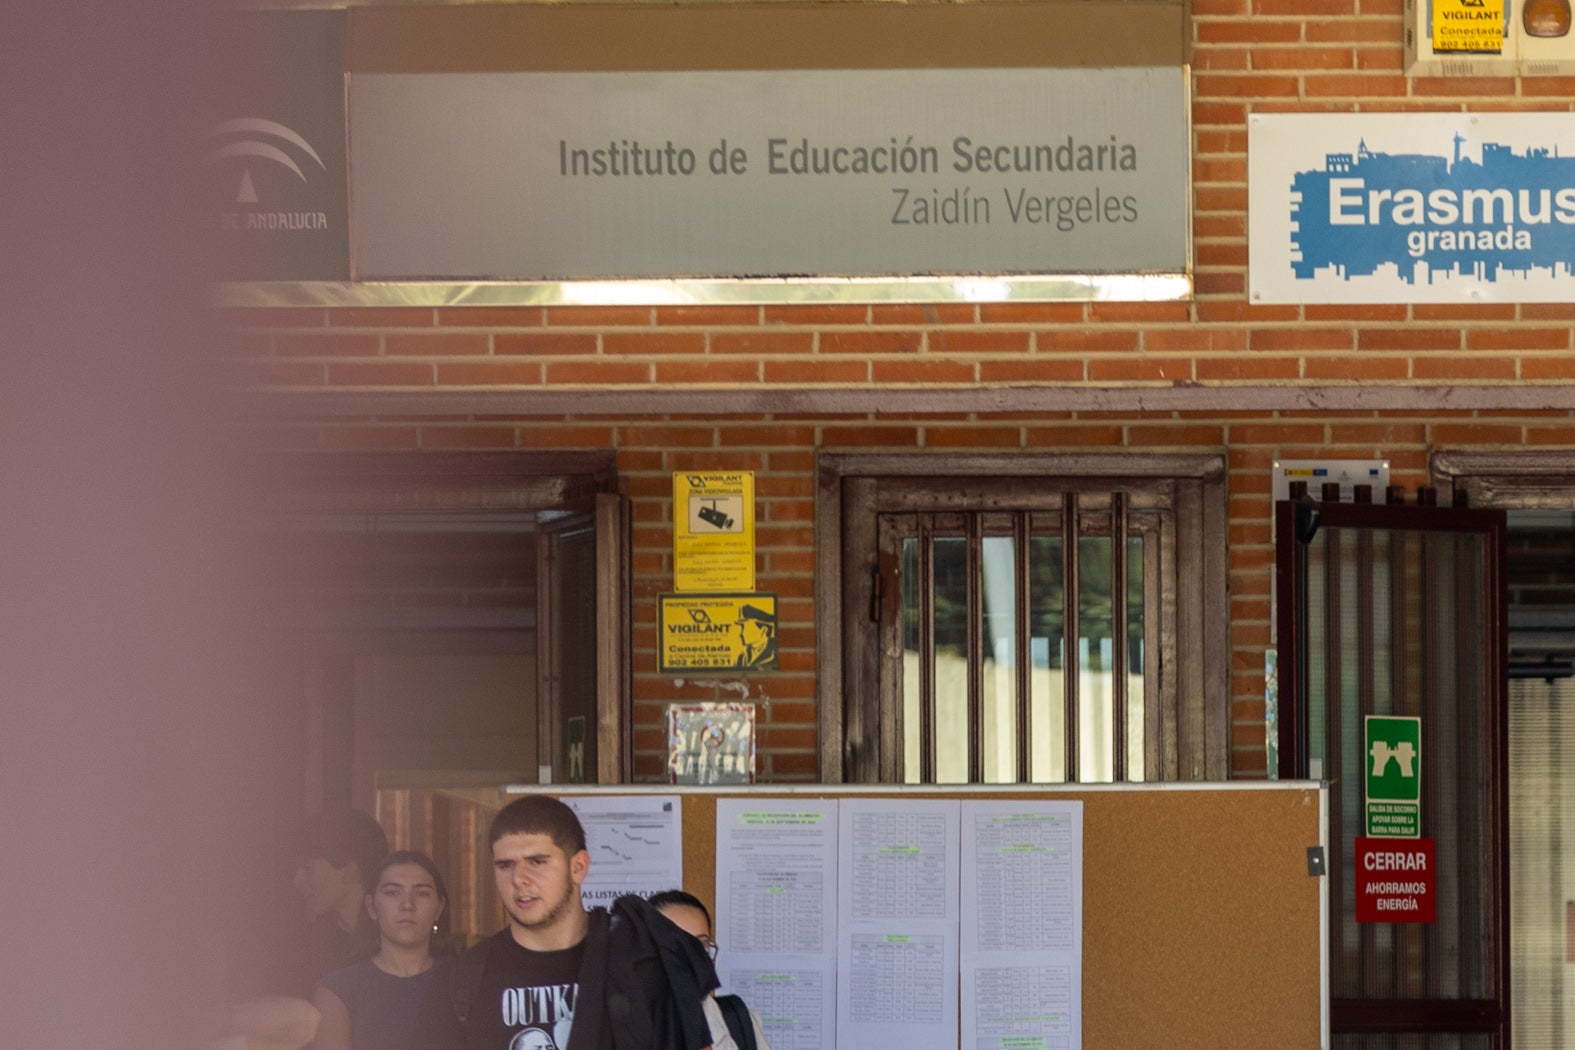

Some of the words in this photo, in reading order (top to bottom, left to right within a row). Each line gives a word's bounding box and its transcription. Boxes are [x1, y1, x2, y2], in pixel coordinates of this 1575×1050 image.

[1442, 11, 1499, 20] VIGILANT
[1440, 26, 1502, 35] Conectada
[559, 138, 696, 176] Instituto
[708, 137, 748, 175] de
[767, 135, 939, 175] Educación
[952, 135, 1138, 173] Secundaria
[890, 186, 991, 225] Zaidín
[1003, 186, 1139, 232] Vergeles
[1407, 225, 1532, 257] granada
[668, 624, 732, 633] VIGILANT
[669, 645, 731, 653] Conectada
[1369, 804, 1386, 813] SALIDA
[1387, 804, 1393, 813] DE
[1394, 805, 1417, 814] SOCORRO
[1372, 814, 1390, 823] APOYAR
[1391, 815, 1407, 824] SOBRE
[1408, 815, 1414, 824] LA
[1372, 824, 1387, 833] BARRA
[1388, 825, 1400, 834] PARA
[1364, 851, 1427, 871] CERRAR
[1365, 882, 1426, 895] AHORRAMOS
[595, 890, 623, 899] LISTAS
[1376, 895, 1419, 911] ENERGÍA
[502, 983, 579, 1027] OUTK
